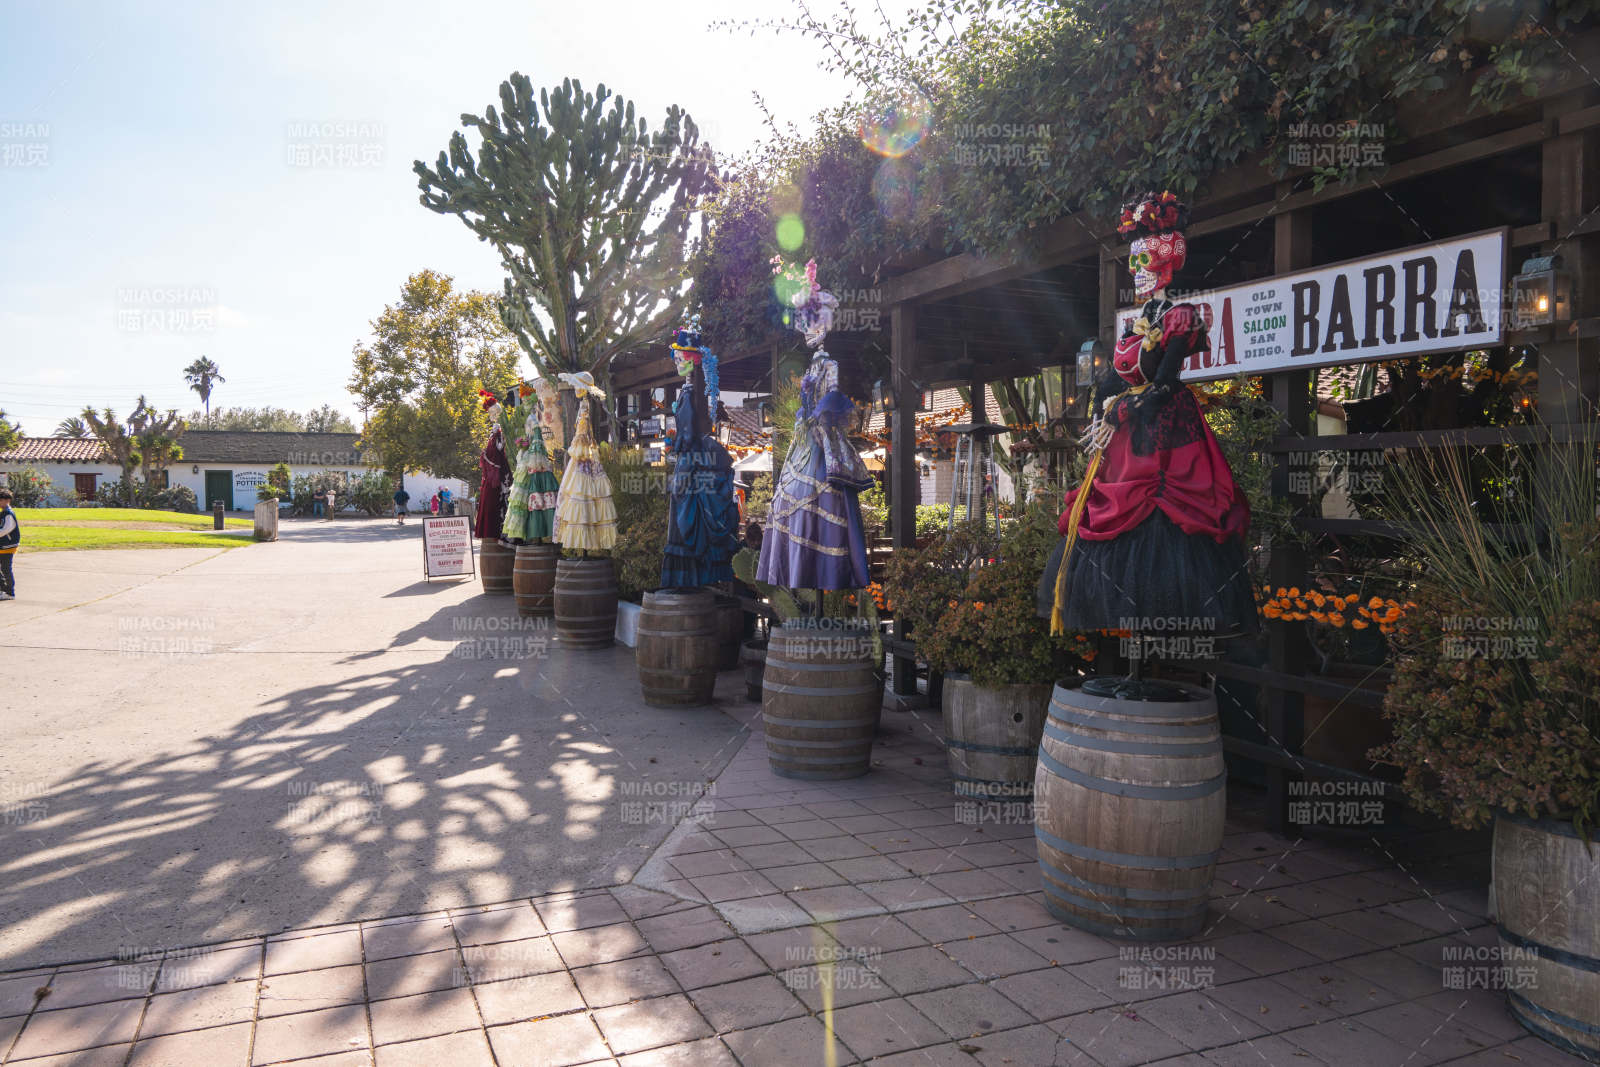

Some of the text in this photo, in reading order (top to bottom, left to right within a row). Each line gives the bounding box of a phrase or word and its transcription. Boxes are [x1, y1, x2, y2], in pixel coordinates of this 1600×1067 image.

[1252, 289, 1276, 302] OLD
[1245, 302, 1283, 317] TOWN
[1243, 315, 1287, 335] SALOON
[1250, 333, 1276, 345] SAN
[1244, 345, 1285, 359] DIEGO.
